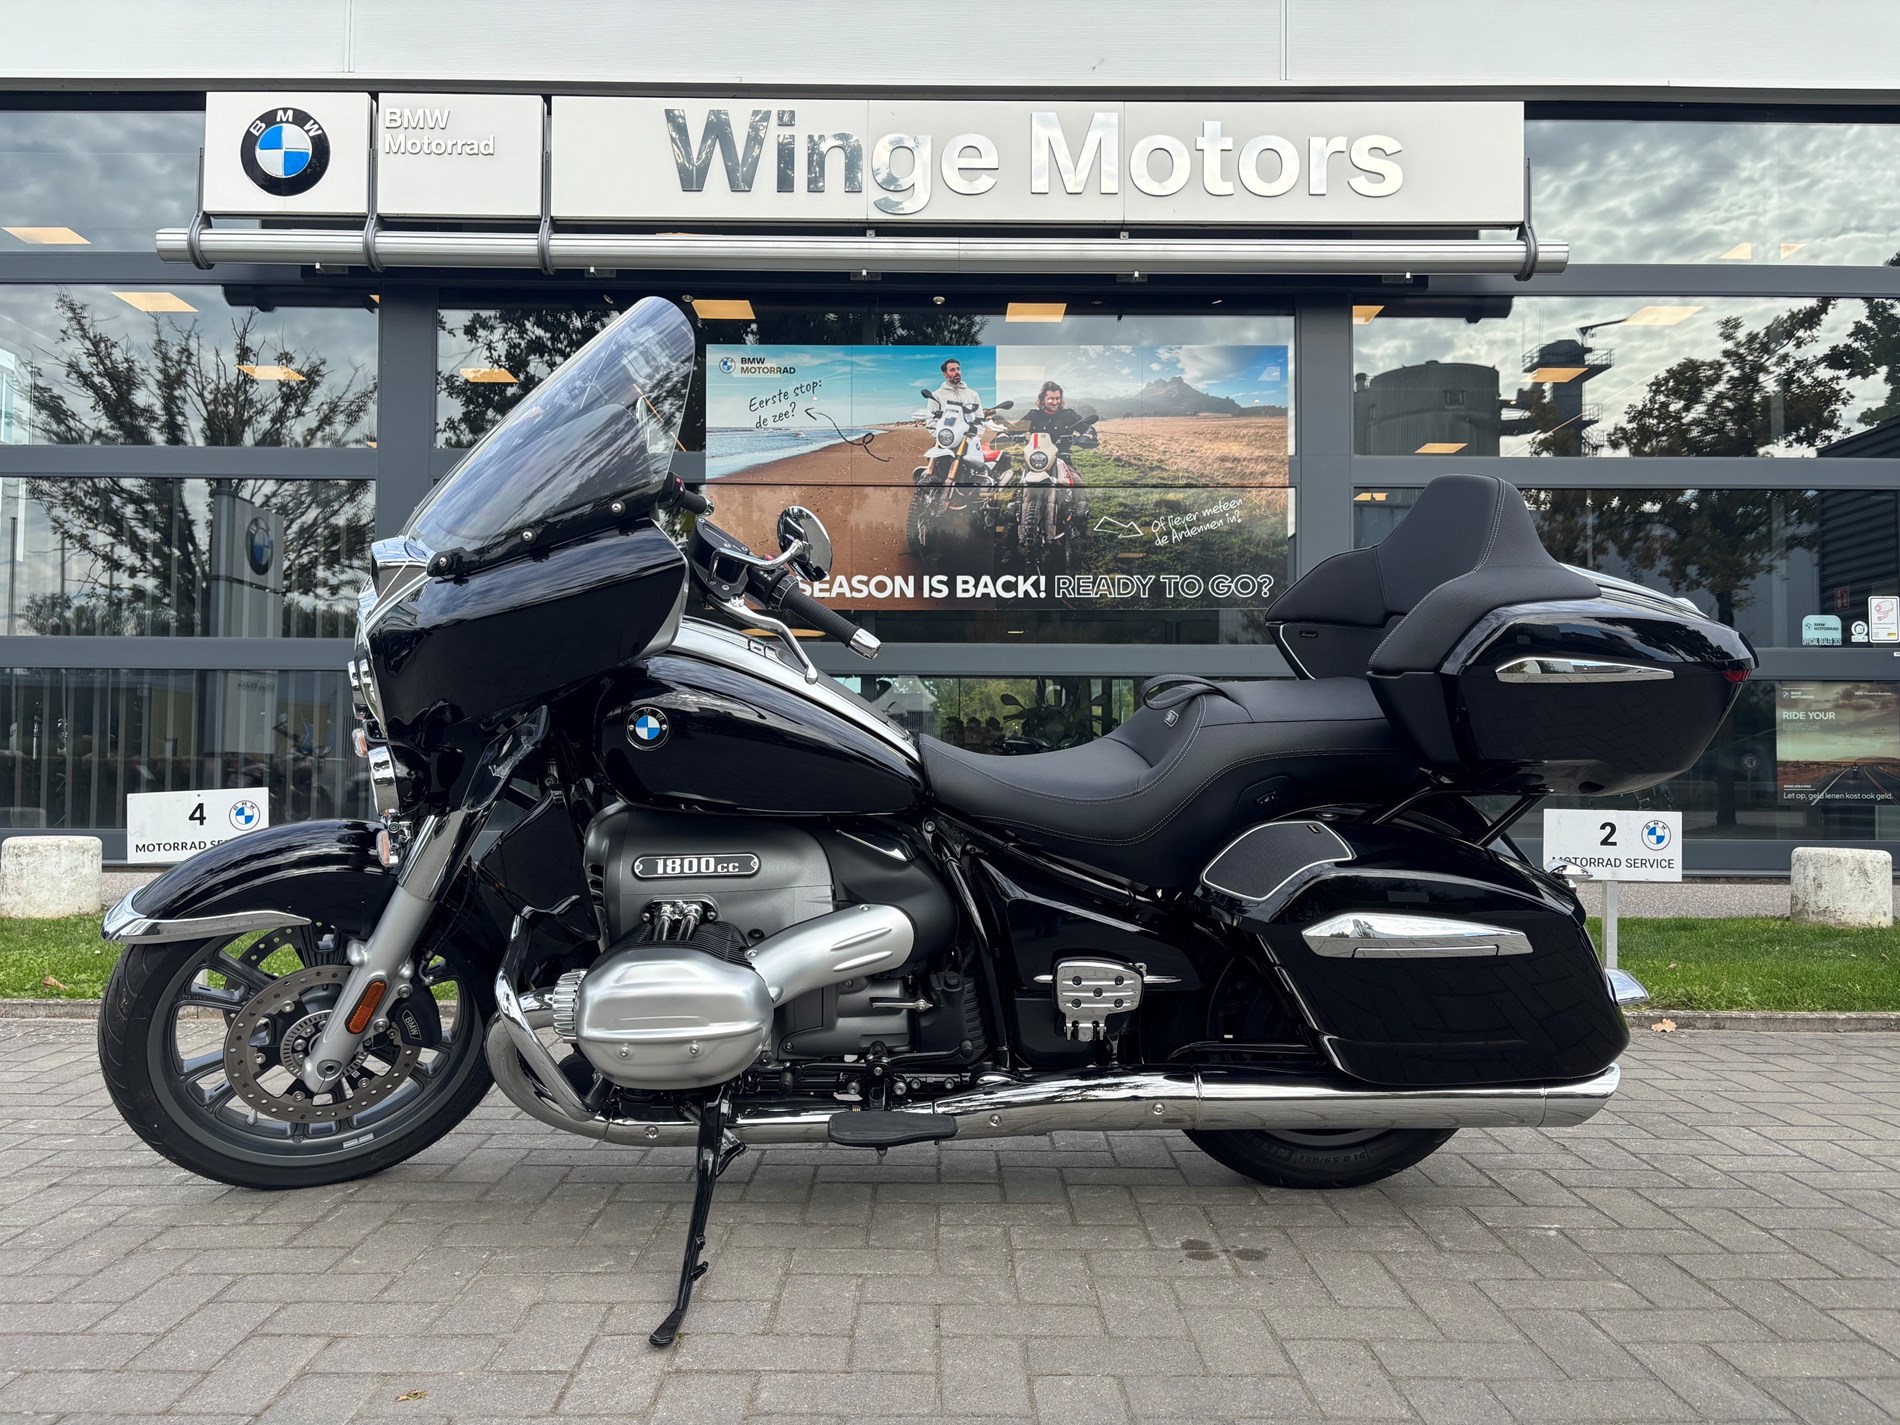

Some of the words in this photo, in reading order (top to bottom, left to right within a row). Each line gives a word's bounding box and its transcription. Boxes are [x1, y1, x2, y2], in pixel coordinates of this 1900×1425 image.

[248, 109, 323, 137] BMW
[385, 108, 450, 130] BMW
[384, 133, 495, 156] Motorrad
[663, 108, 1000, 215] Winge
[1030, 111, 1404, 198] Motors
[740, 357, 766, 365] BMW
[740, 366, 796, 375] MOTORRAD
[748, 389, 789, 412] Eerste
[793, 379, 822, 397] stop:
[755, 415, 768, 429] de
[772, 401, 797, 423] zee?
[1151, 516, 1167, 533] Of
[1167, 511, 1199, 530] liever
[1202, 498, 1243, 517] meteen
[1154, 533, 1170, 547] de
[1171, 518, 1224, 544] Ardennen
[1225, 510, 1242, 524] in?
[799, 574, 915, 598] SEASON
[922, 574, 950, 598] IS
[956, 574, 1047, 598] BACK!
[1054, 574, 1156, 598] READY
[1160, 574, 1204, 598] TO
[1208, 574, 1274, 599] GO?
[630, 708, 665, 722] BMW
[1782, 711, 1806, 720] RIDE
[1807, 711, 1836, 720] YOUR
[1783, 791, 1795, 799] Let
[1796, 793, 1808, 801] op,
[188, 802, 207, 826] 4
[1599, 822, 1618, 847] 2
[135, 841, 207, 853] MOTORRAD
[1552, 856, 1622, 868] TORRAD
[1625, 858, 1675, 869] SERVICE
[404, 1016, 419, 1035] BMW
